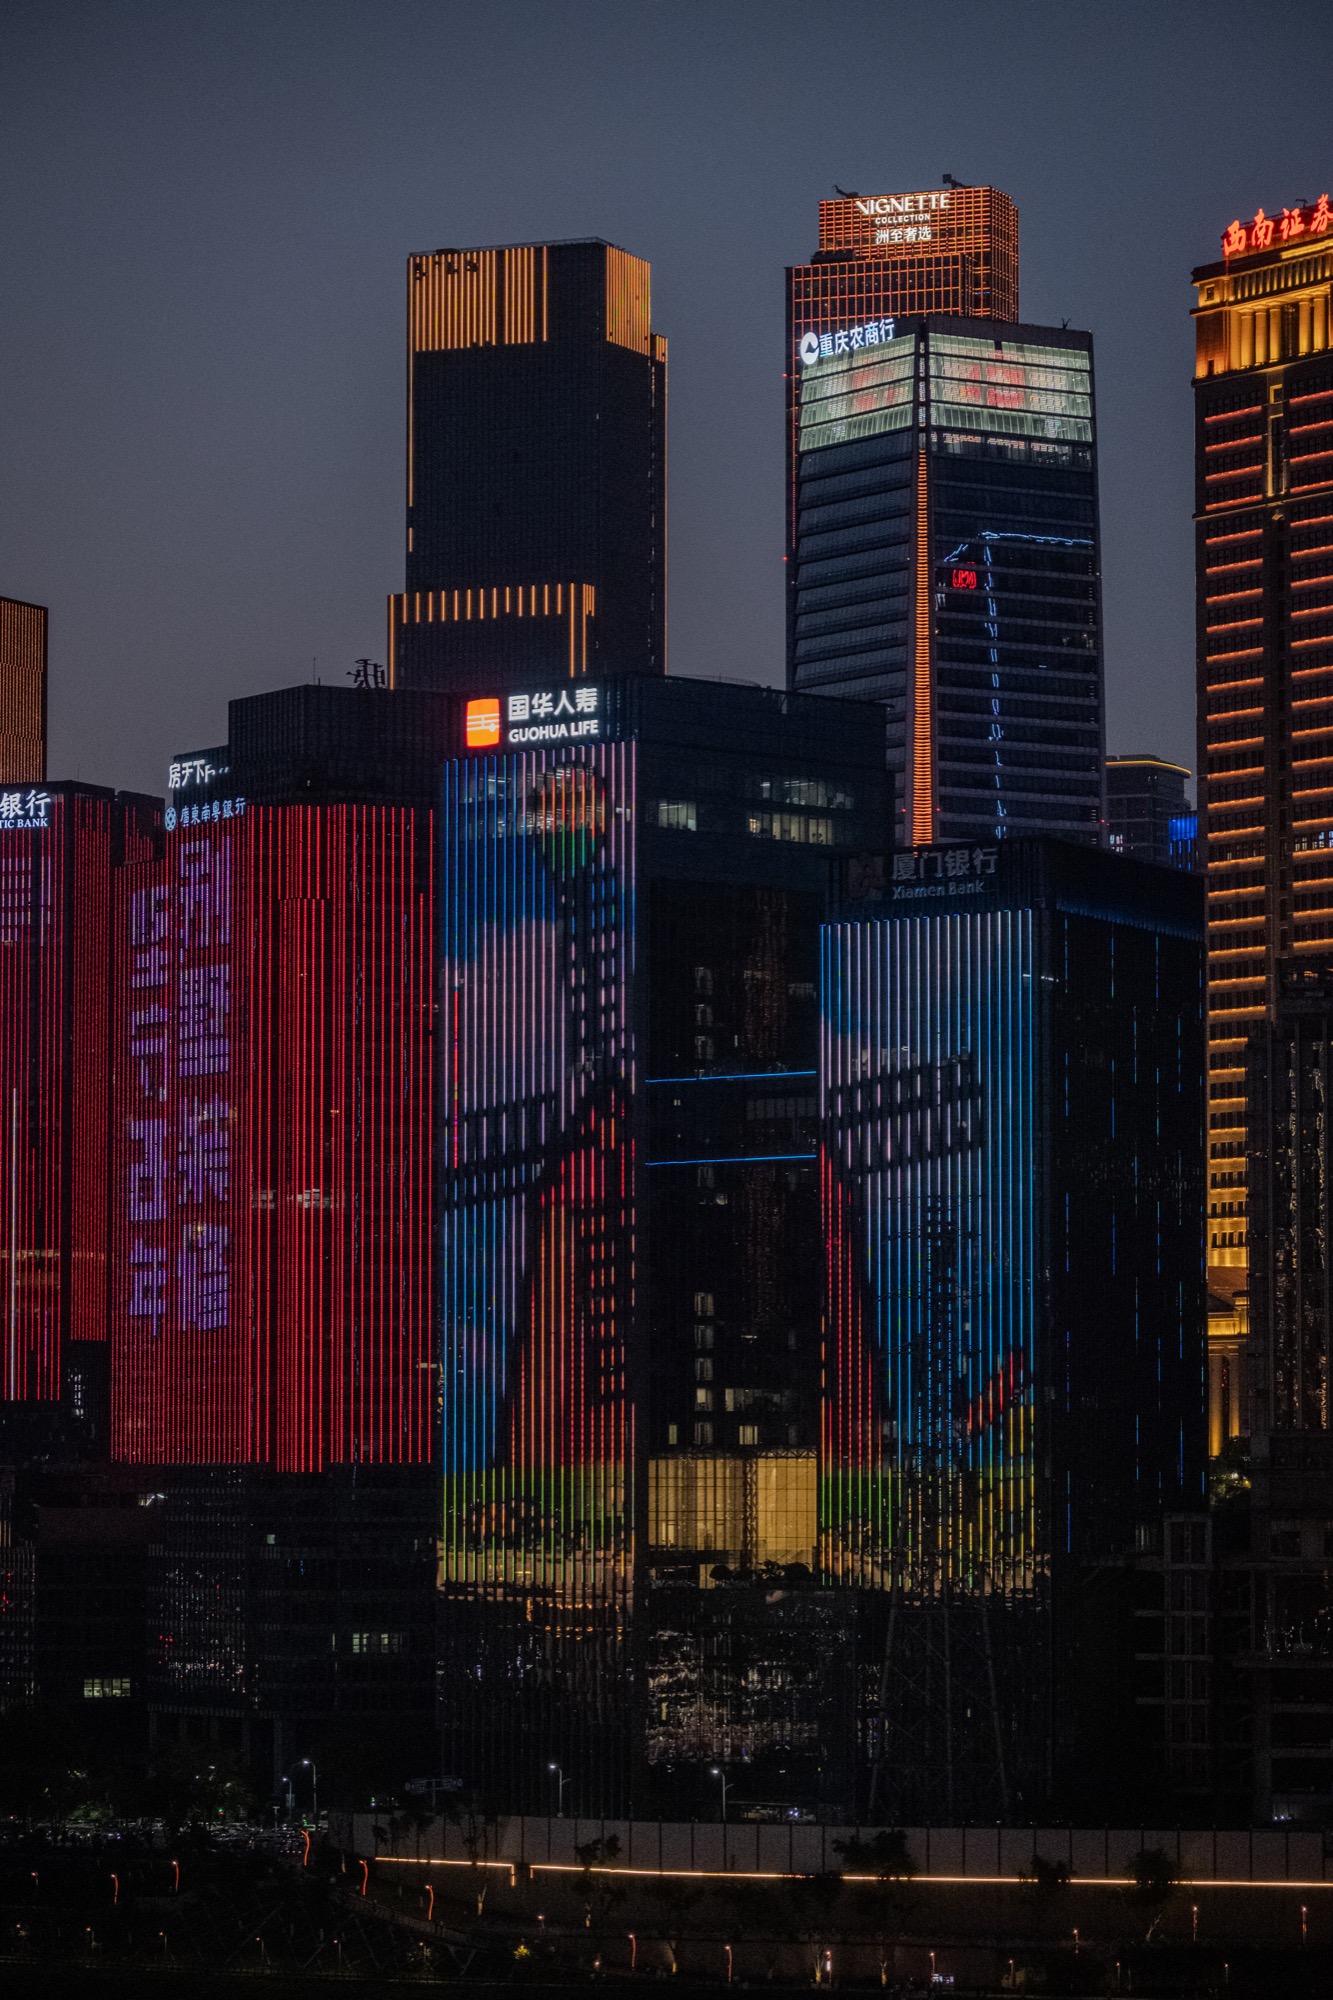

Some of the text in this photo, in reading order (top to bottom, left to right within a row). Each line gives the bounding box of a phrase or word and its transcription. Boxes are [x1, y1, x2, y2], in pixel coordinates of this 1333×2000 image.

[856, 193, 950, 215] VIGNETTE
[876, 214, 931, 225] COLLECTION
[1223, 193, 1333, 256] 西南证券
[876, 226, 932, 244] 洲至奢选
[819, 318, 895, 357] 重庆农商行
[508, 688, 597, 720] 国华人寿
[509, 719, 598, 742] GUOHUA LIFE
[0, 789, 51, 818] 银行
[17, 818, 49, 828] BANK
[893, 848, 998, 881] 厦门银行
[893, 881, 984, 899] Xiamen Bank
